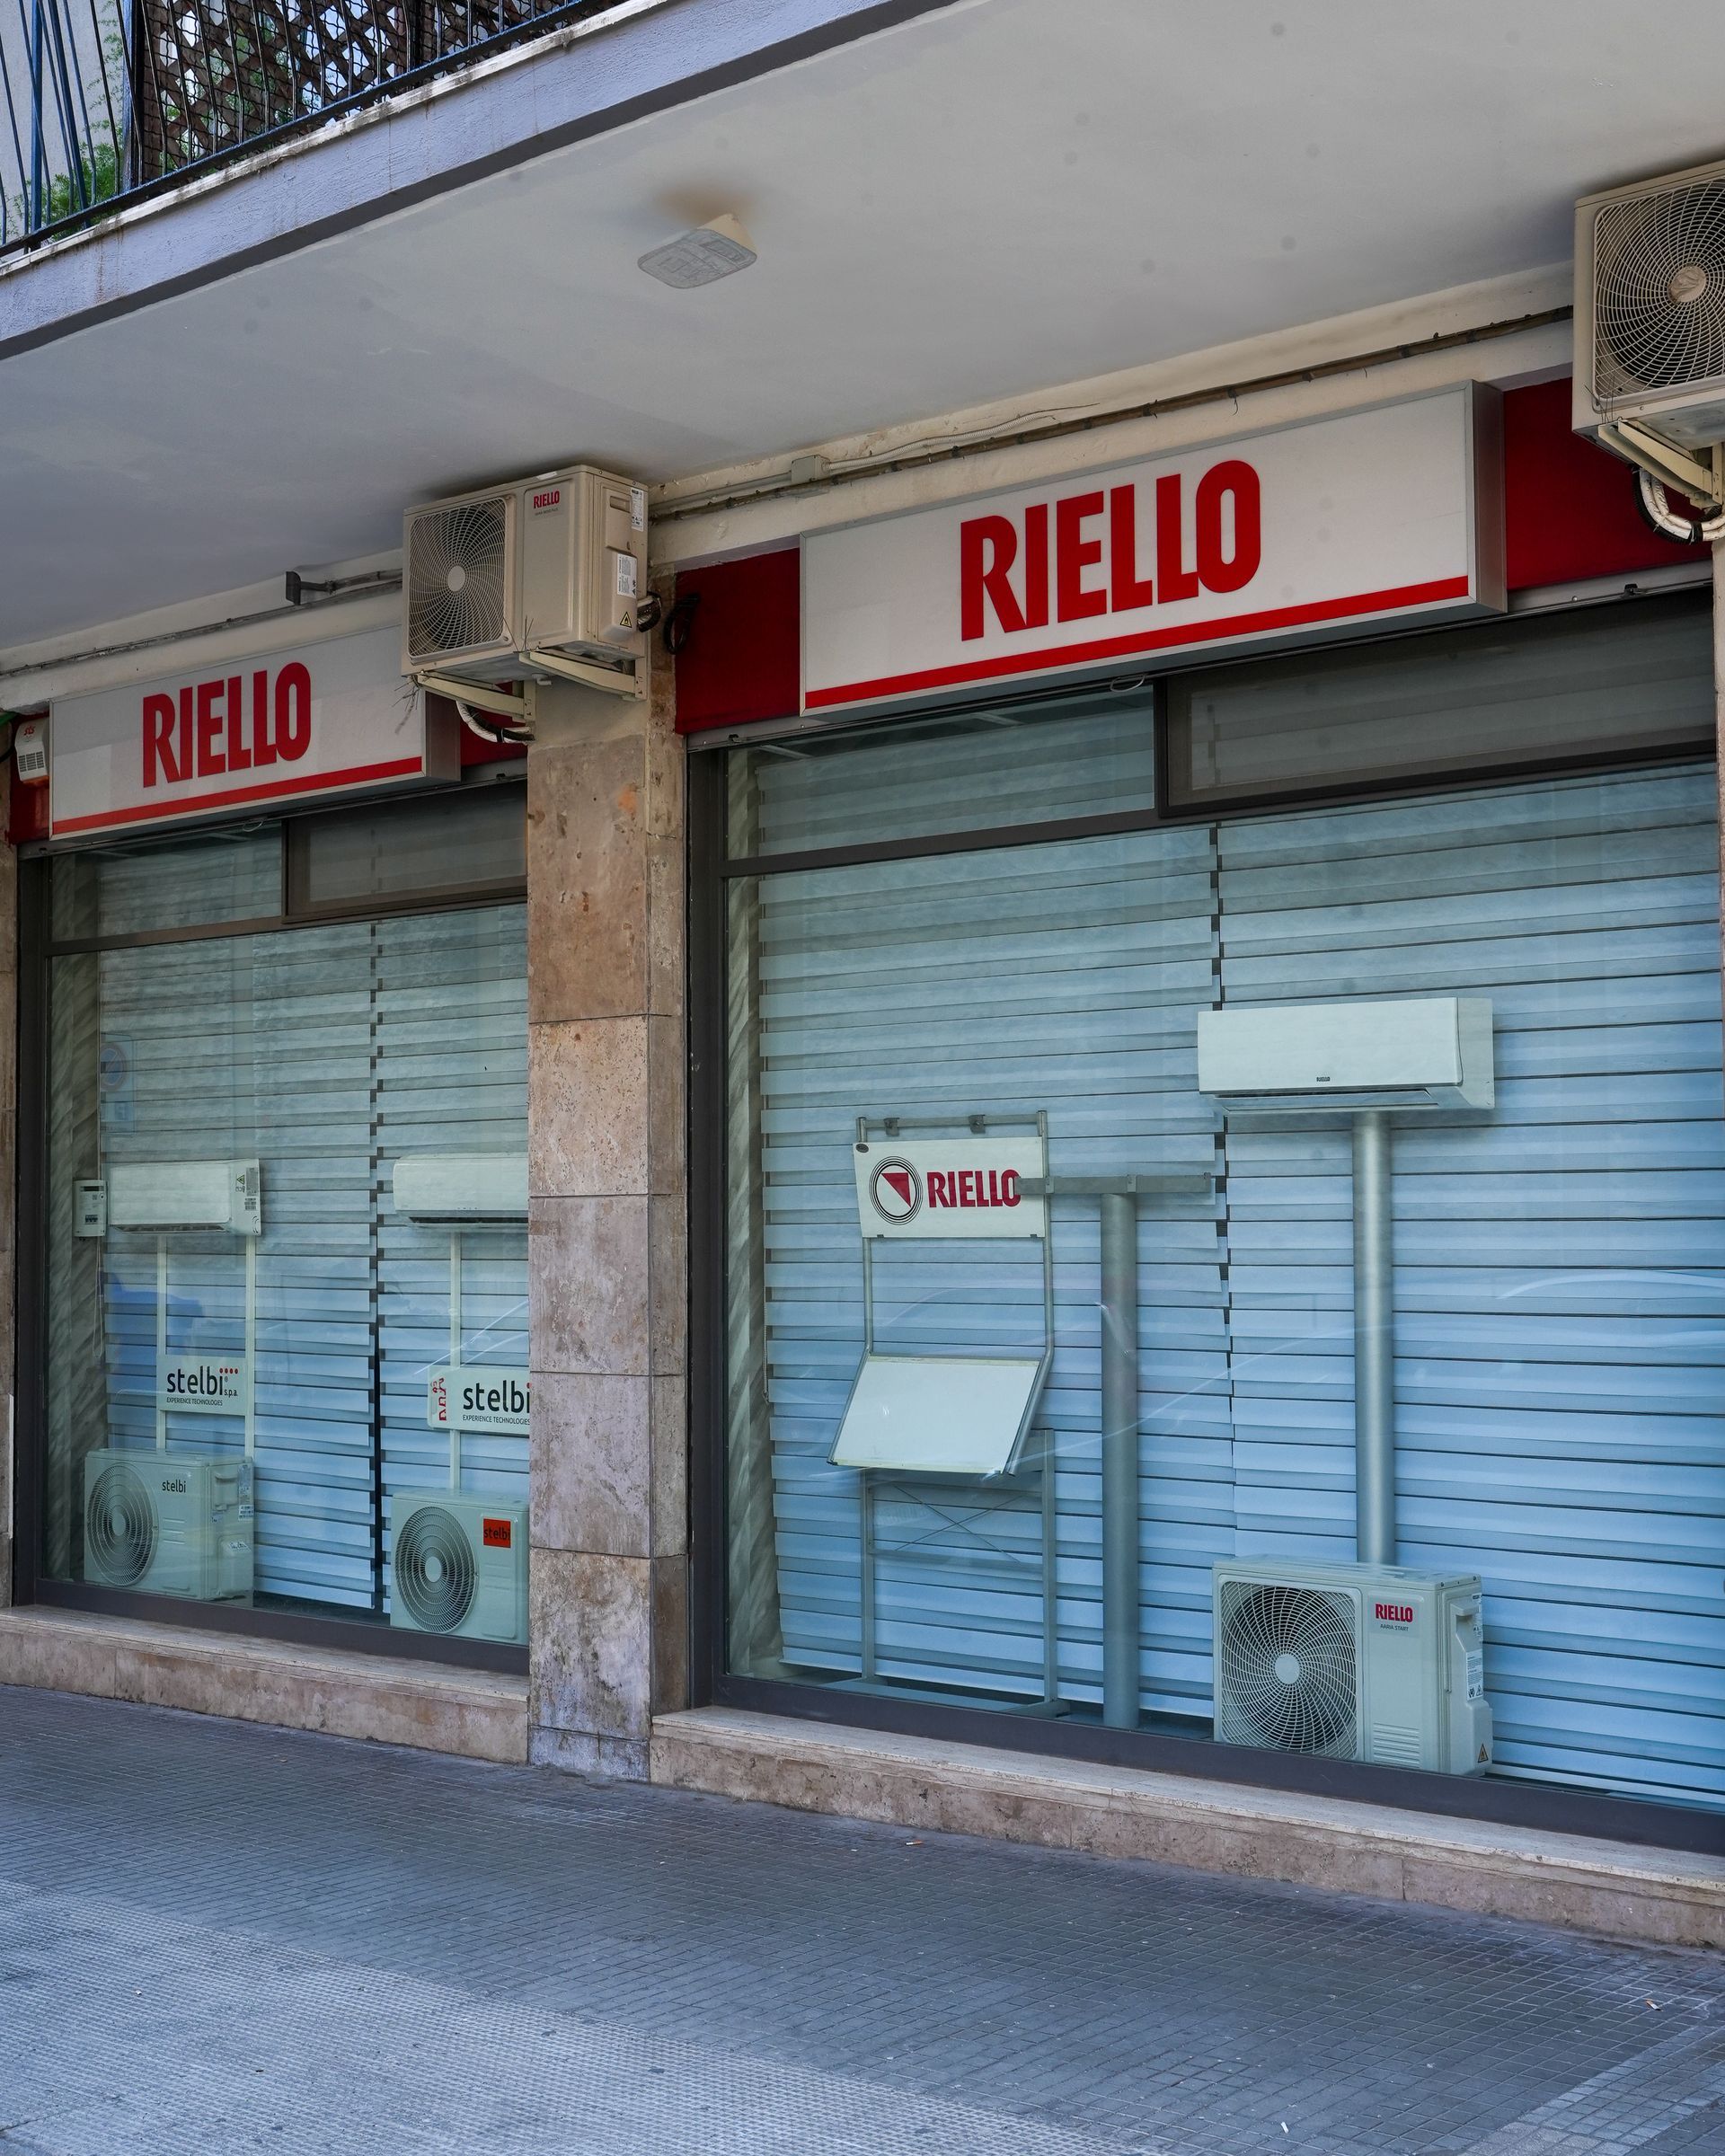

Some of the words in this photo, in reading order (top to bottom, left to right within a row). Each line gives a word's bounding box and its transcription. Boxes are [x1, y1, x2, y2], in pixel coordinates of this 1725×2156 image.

[533, 490, 561, 509] RIELLO
[960, 460, 1261, 641] RIELLO
[143, 662, 311, 788] RIELLO
[926, 1169, 1022, 1208] RIELLO
[166, 1365, 223, 1396] stelbi
[166, 1396, 191, 1405] EXPERIENCE
[191, 1398, 223, 1407] TECHNOLOGIES
[463, 1380, 530, 1414] stelbi
[462, 1414, 492, 1424] EXPERIENCE
[492, 1417, 530, 1426] TECHNOLOGIES
[162, 1479, 187, 1493] stelbi
[483, 1527, 511, 1541] stelbi
[1376, 1603, 1413, 1623] RIELLO
